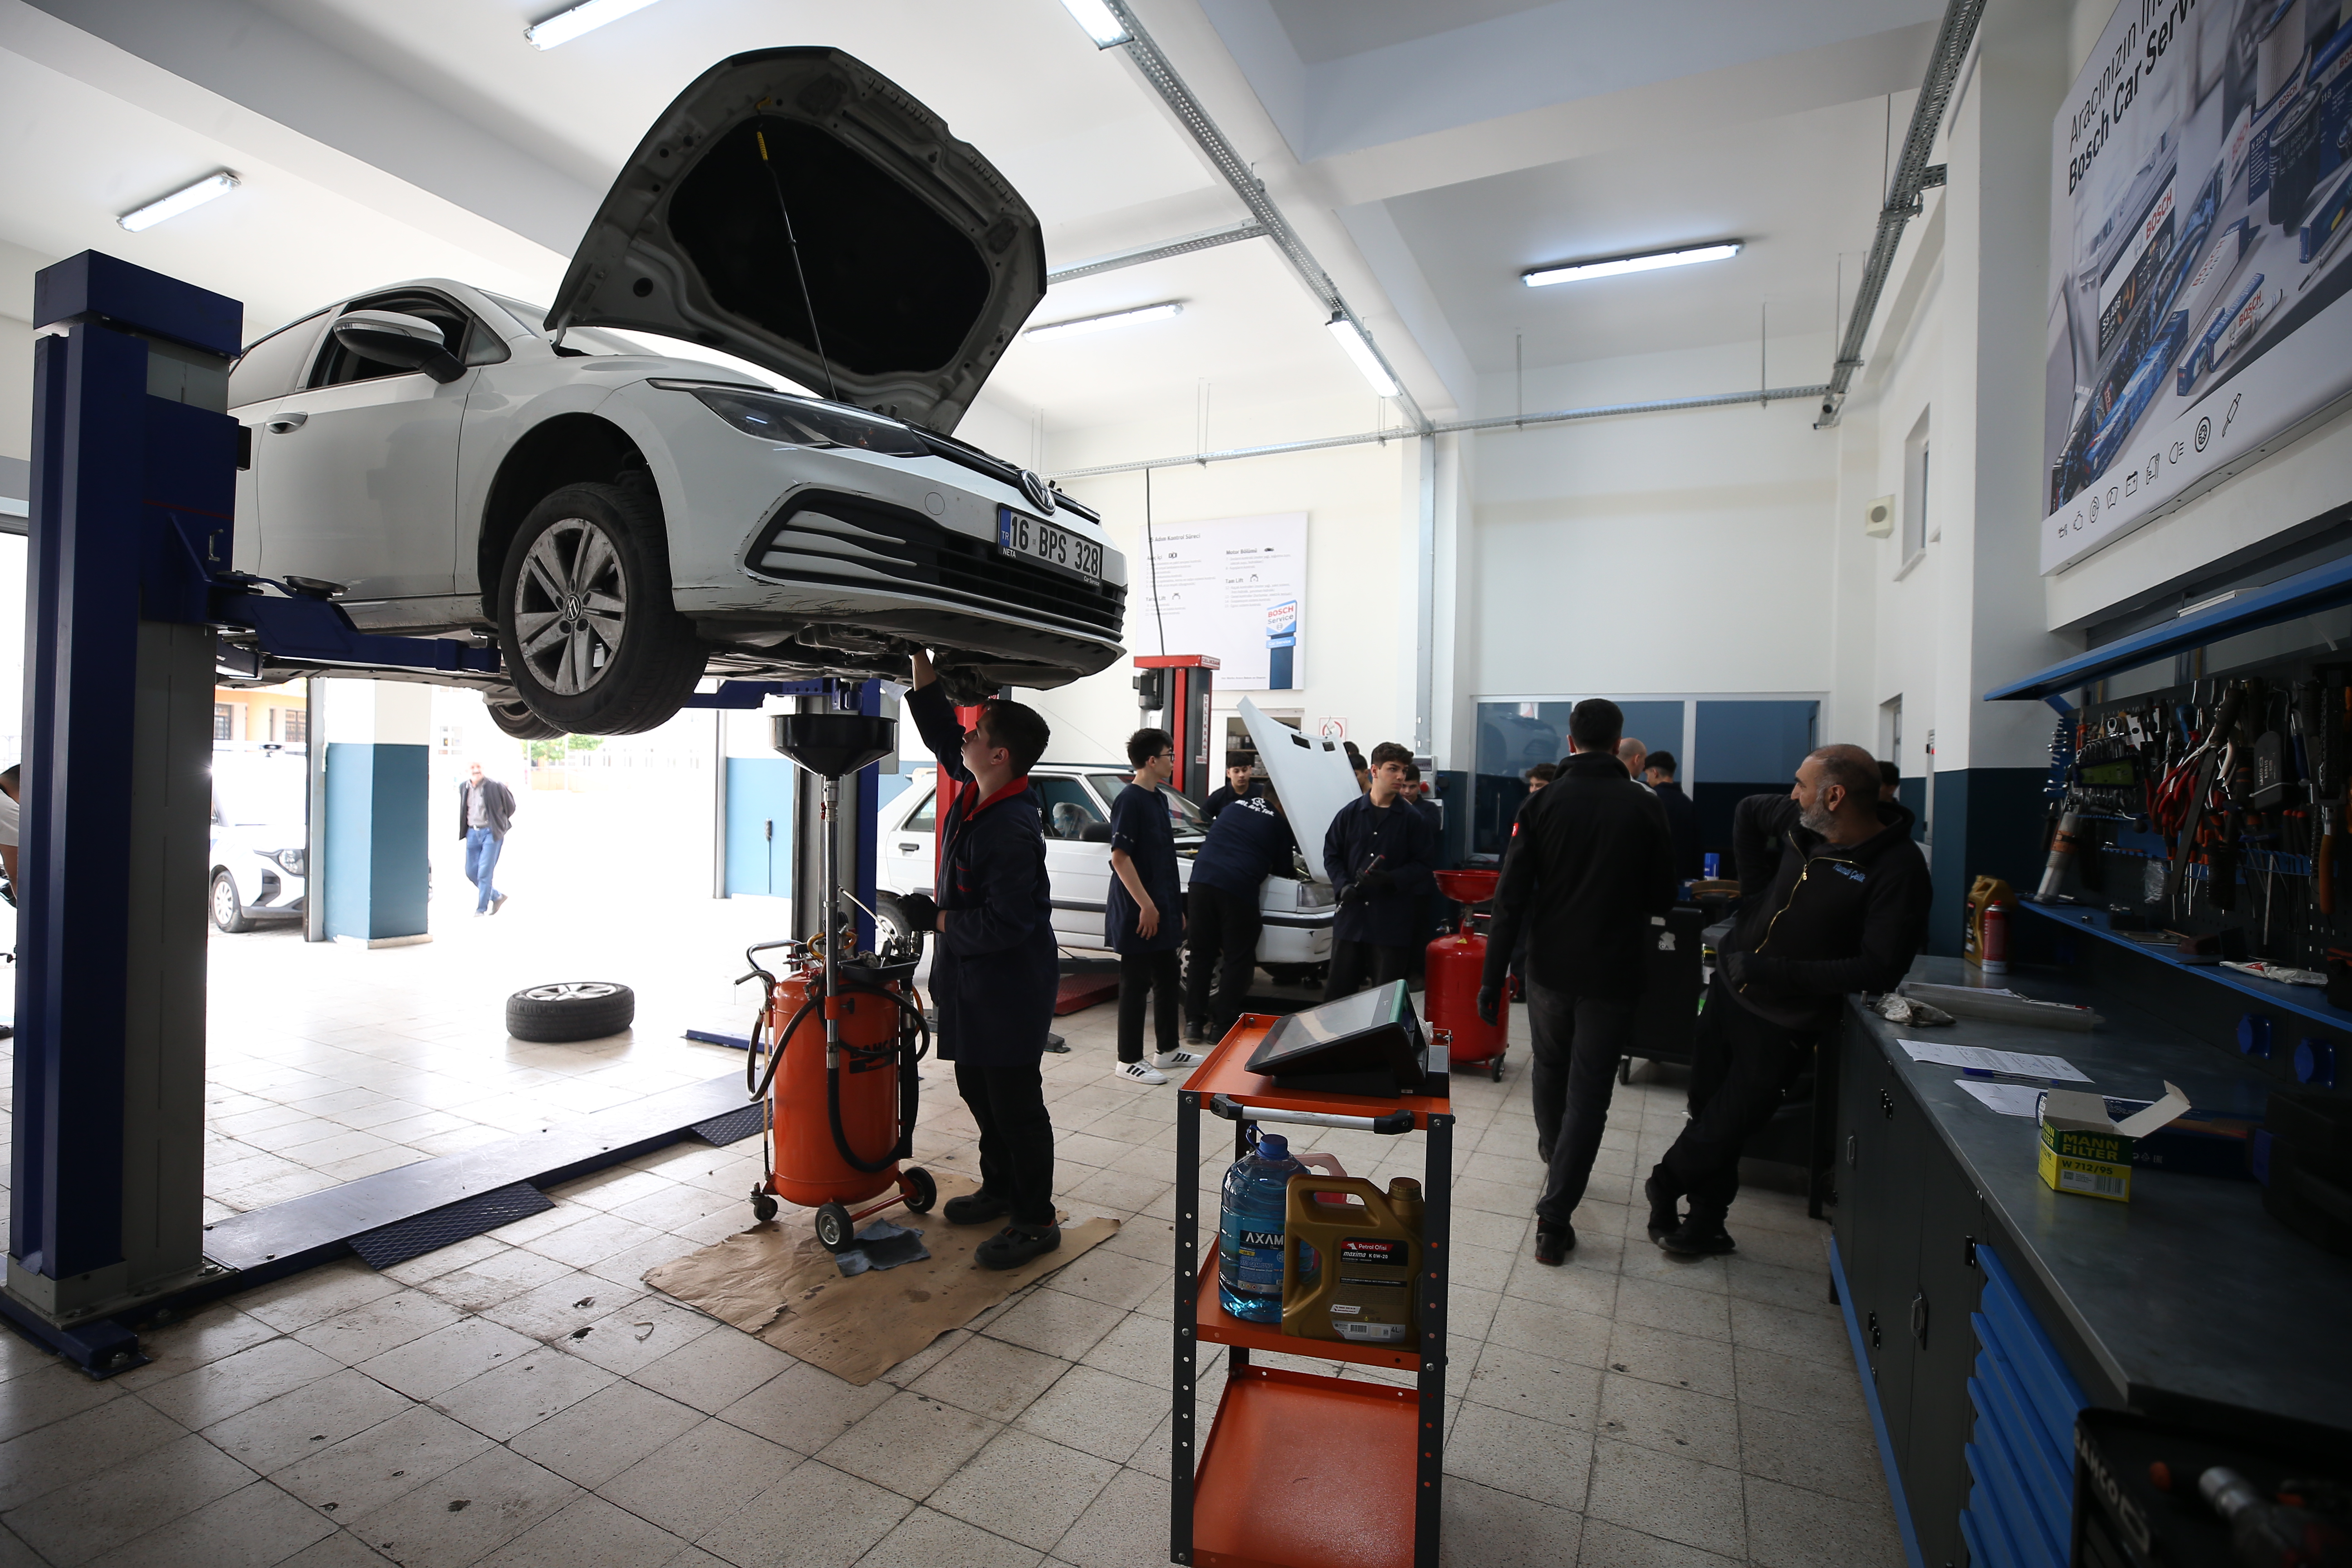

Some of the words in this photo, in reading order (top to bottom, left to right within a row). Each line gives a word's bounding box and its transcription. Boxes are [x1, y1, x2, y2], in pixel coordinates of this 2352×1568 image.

[2069, 22, 2136, 153] Aracınızın
[2069, 108, 2109, 196] Bosch
[2114, 59, 2142, 124] Car
[2145, 0, 2195, 75] Serv
[2278, 83, 2297, 108] BOSCH
[2251, 142, 2255, 151] N
[2255, 130, 2268, 147] 2120
[2146, 187, 2172, 240] BOSCH
[2192, 239, 2226, 286] BOSCH
[2239, 289, 2261, 328] BOSCH
[1001, 530, 1009, 541] TR
[1011, 516, 1029, 551] 16
[1039, 526, 1067, 564] BPS
[1075, 540, 1099, 576] 328
[1003, 548, 1016, 559] NETA
[1089, 577, 1100, 587] Service
[1268, 605, 1294, 617] BOSCH
[1268, 614, 1294, 624] Service
[1833, 862, 1853, 876] Hamdi
[1849, 870, 1866, 883] Çelik
[2062, 1143, 2118, 1161] FILTER
[2063, 1133, 2119, 1151] MANN
[2062, 1159, 2072, 1168] W
[2074, 1162, 2113, 1175] 712/95
